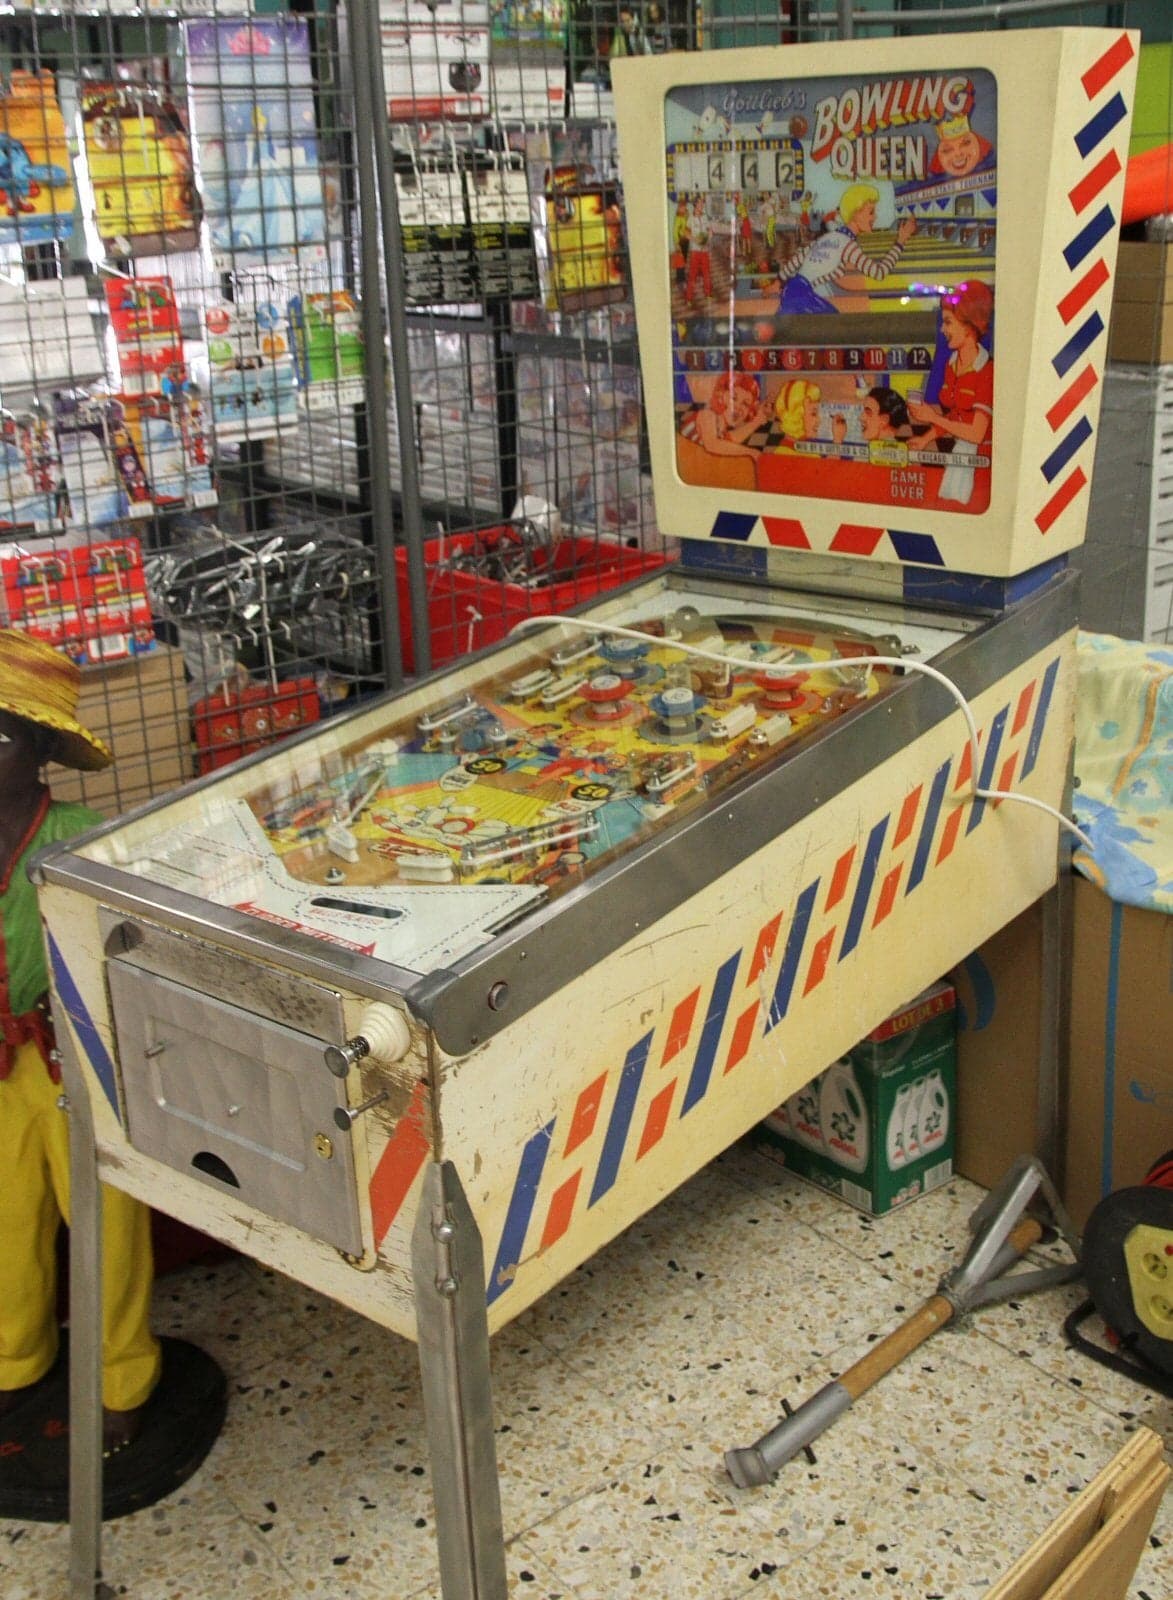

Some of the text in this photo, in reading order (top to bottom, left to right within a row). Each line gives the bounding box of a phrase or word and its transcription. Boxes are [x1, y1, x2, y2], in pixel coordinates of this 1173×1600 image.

[811, 76, 971, 157] BOWLING
[831, 135, 925, 180] QUEEN
[712, 162, 793, 184] 4 4 2
[693, 350, 699, 366] 1
[710, 350, 718, 366] 2
[749, 349, 758, 366] 4
[768, 349, 777, 366] 5
[788, 349, 797, 365] 6
[808, 350, 816, 365] 7
[828, 350, 837, 365] 8
[850, 349, 859, 365] 9
[869, 349, 884, 366] 10
[890, 349, 902, 365] 11
[912, 349, 926, 365] 12
[890, 470, 926, 486] GAME
[891, 485, 924, 499] OVER
[472, 760, 502, 772] 50
[577, 785, 609, 798] 50
[892, 1010, 916, 1032] LOT
